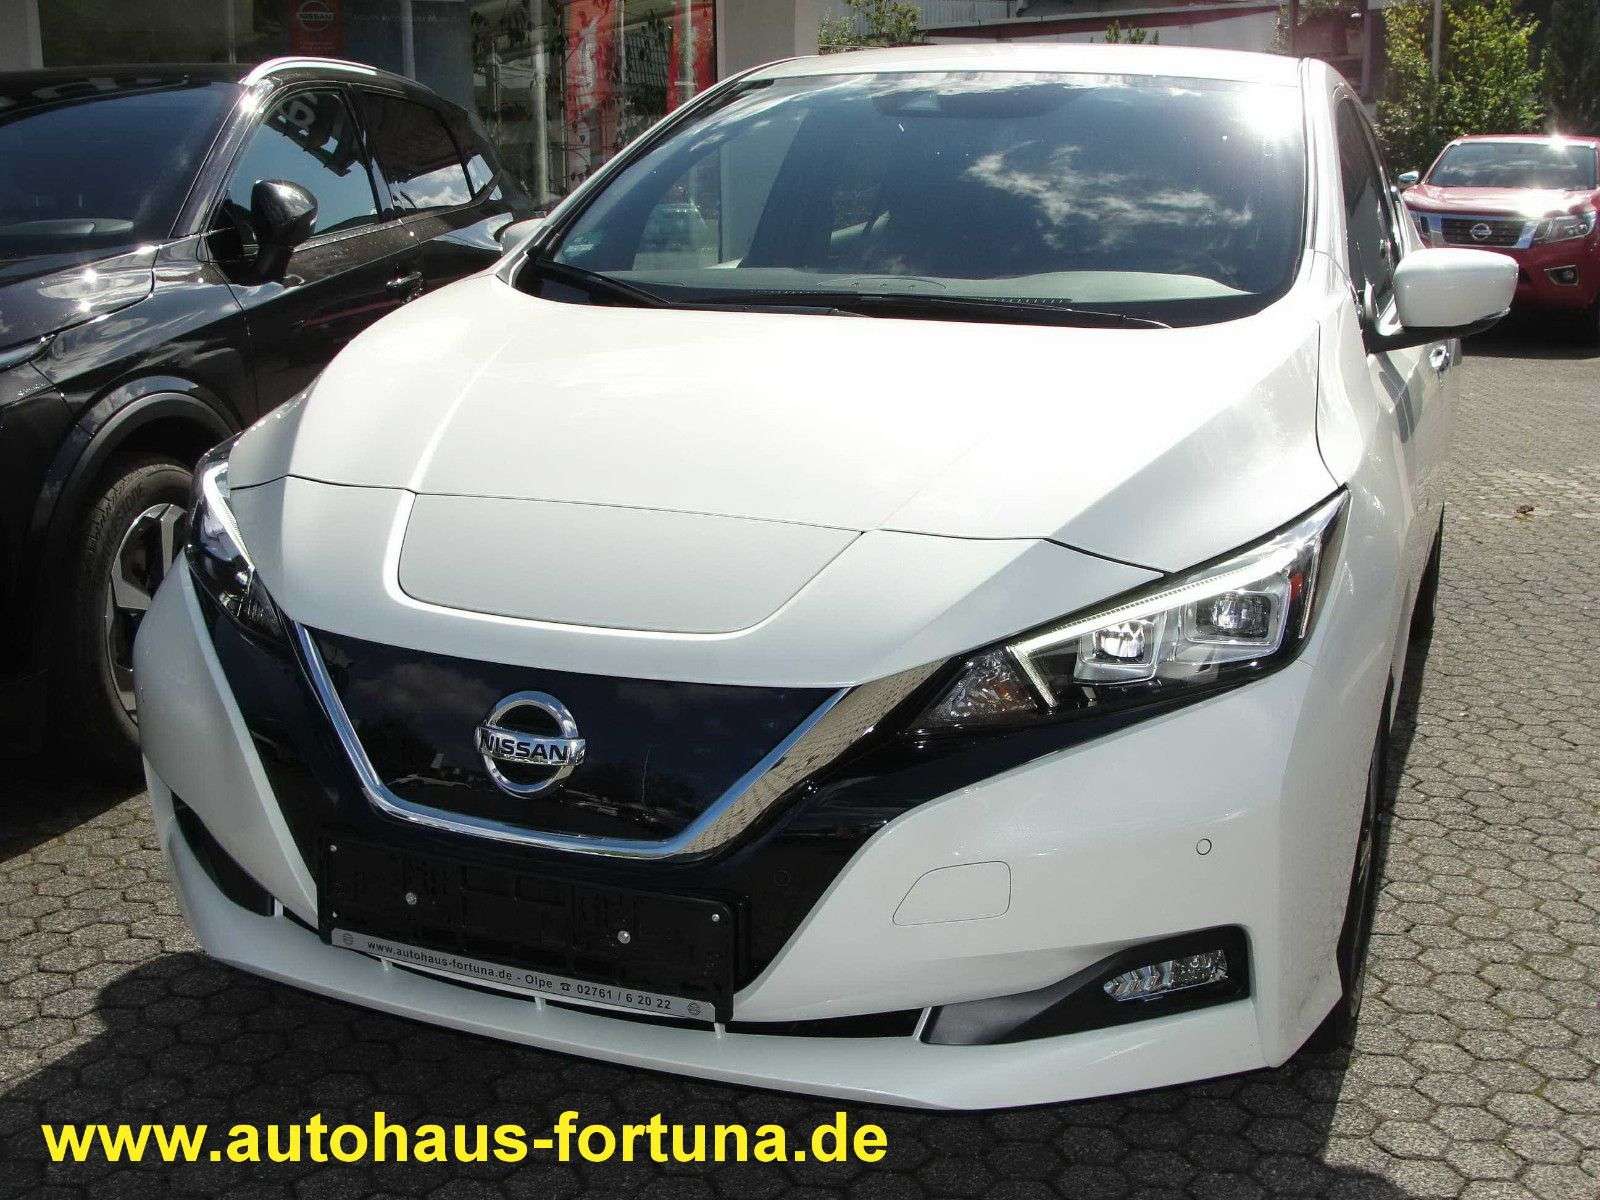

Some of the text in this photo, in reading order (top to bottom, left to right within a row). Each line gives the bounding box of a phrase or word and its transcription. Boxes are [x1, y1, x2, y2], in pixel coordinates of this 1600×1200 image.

[479, 735, 569, 761] NISSAN
[366, 940, 513, 981] www.autohaus-fortuna.de
[525, 974, 553, 990] Olpe
[577, 984, 613, 1000] 02761
[625, 993, 634, 1003] 6
[637, 994, 652, 1006] 20
[656, 997, 672, 1010] 22
